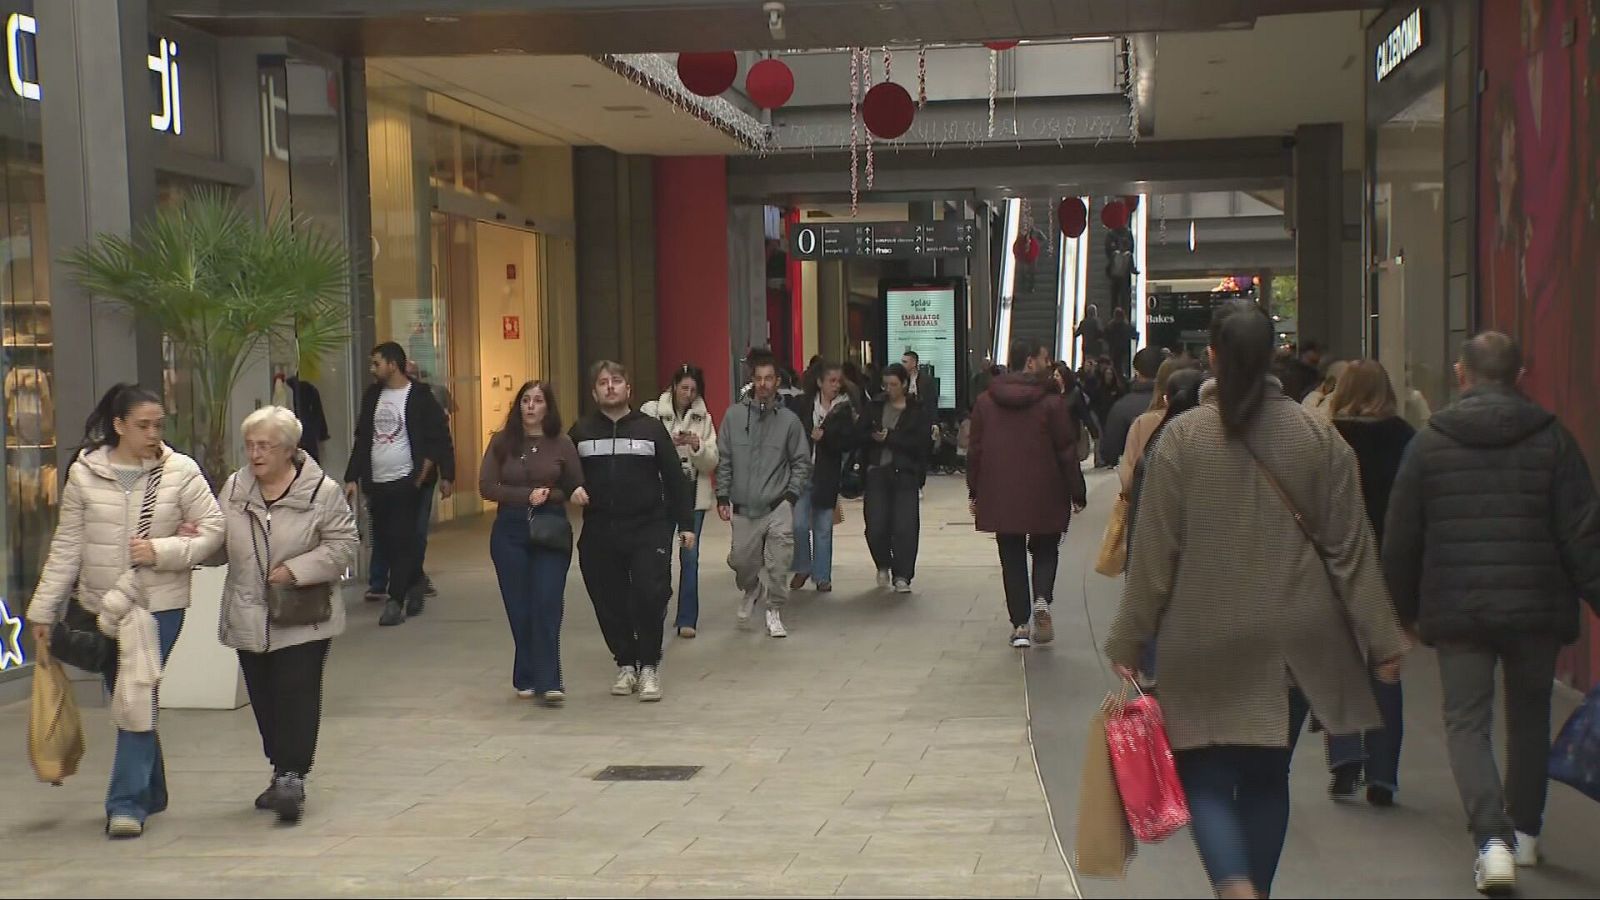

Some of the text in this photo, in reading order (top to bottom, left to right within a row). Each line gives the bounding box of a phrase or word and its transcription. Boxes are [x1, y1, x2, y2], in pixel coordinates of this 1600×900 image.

[1376, 7, 1421, 82] CALZEDONIA
[798, 228, 816, 254] 0
[910, 298, 932, 308] splau
